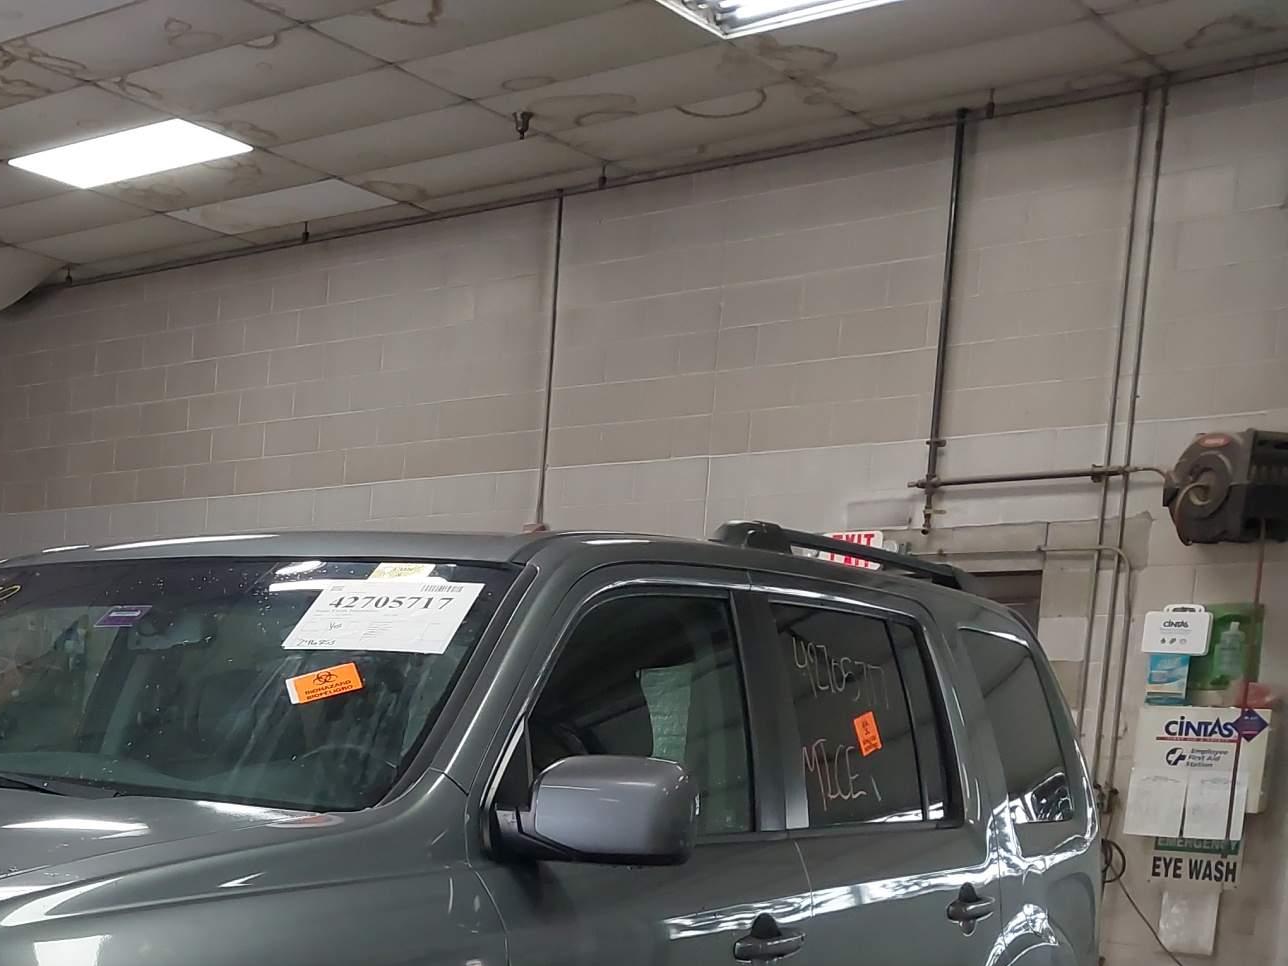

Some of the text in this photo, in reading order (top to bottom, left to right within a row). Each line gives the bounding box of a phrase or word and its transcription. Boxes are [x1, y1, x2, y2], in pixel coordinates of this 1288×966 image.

[329, 596, 455, 610] 42705717
[1164, 715, 1235, 738] CINTAS
[1152, 856, 1236, 882] EYE WASH
